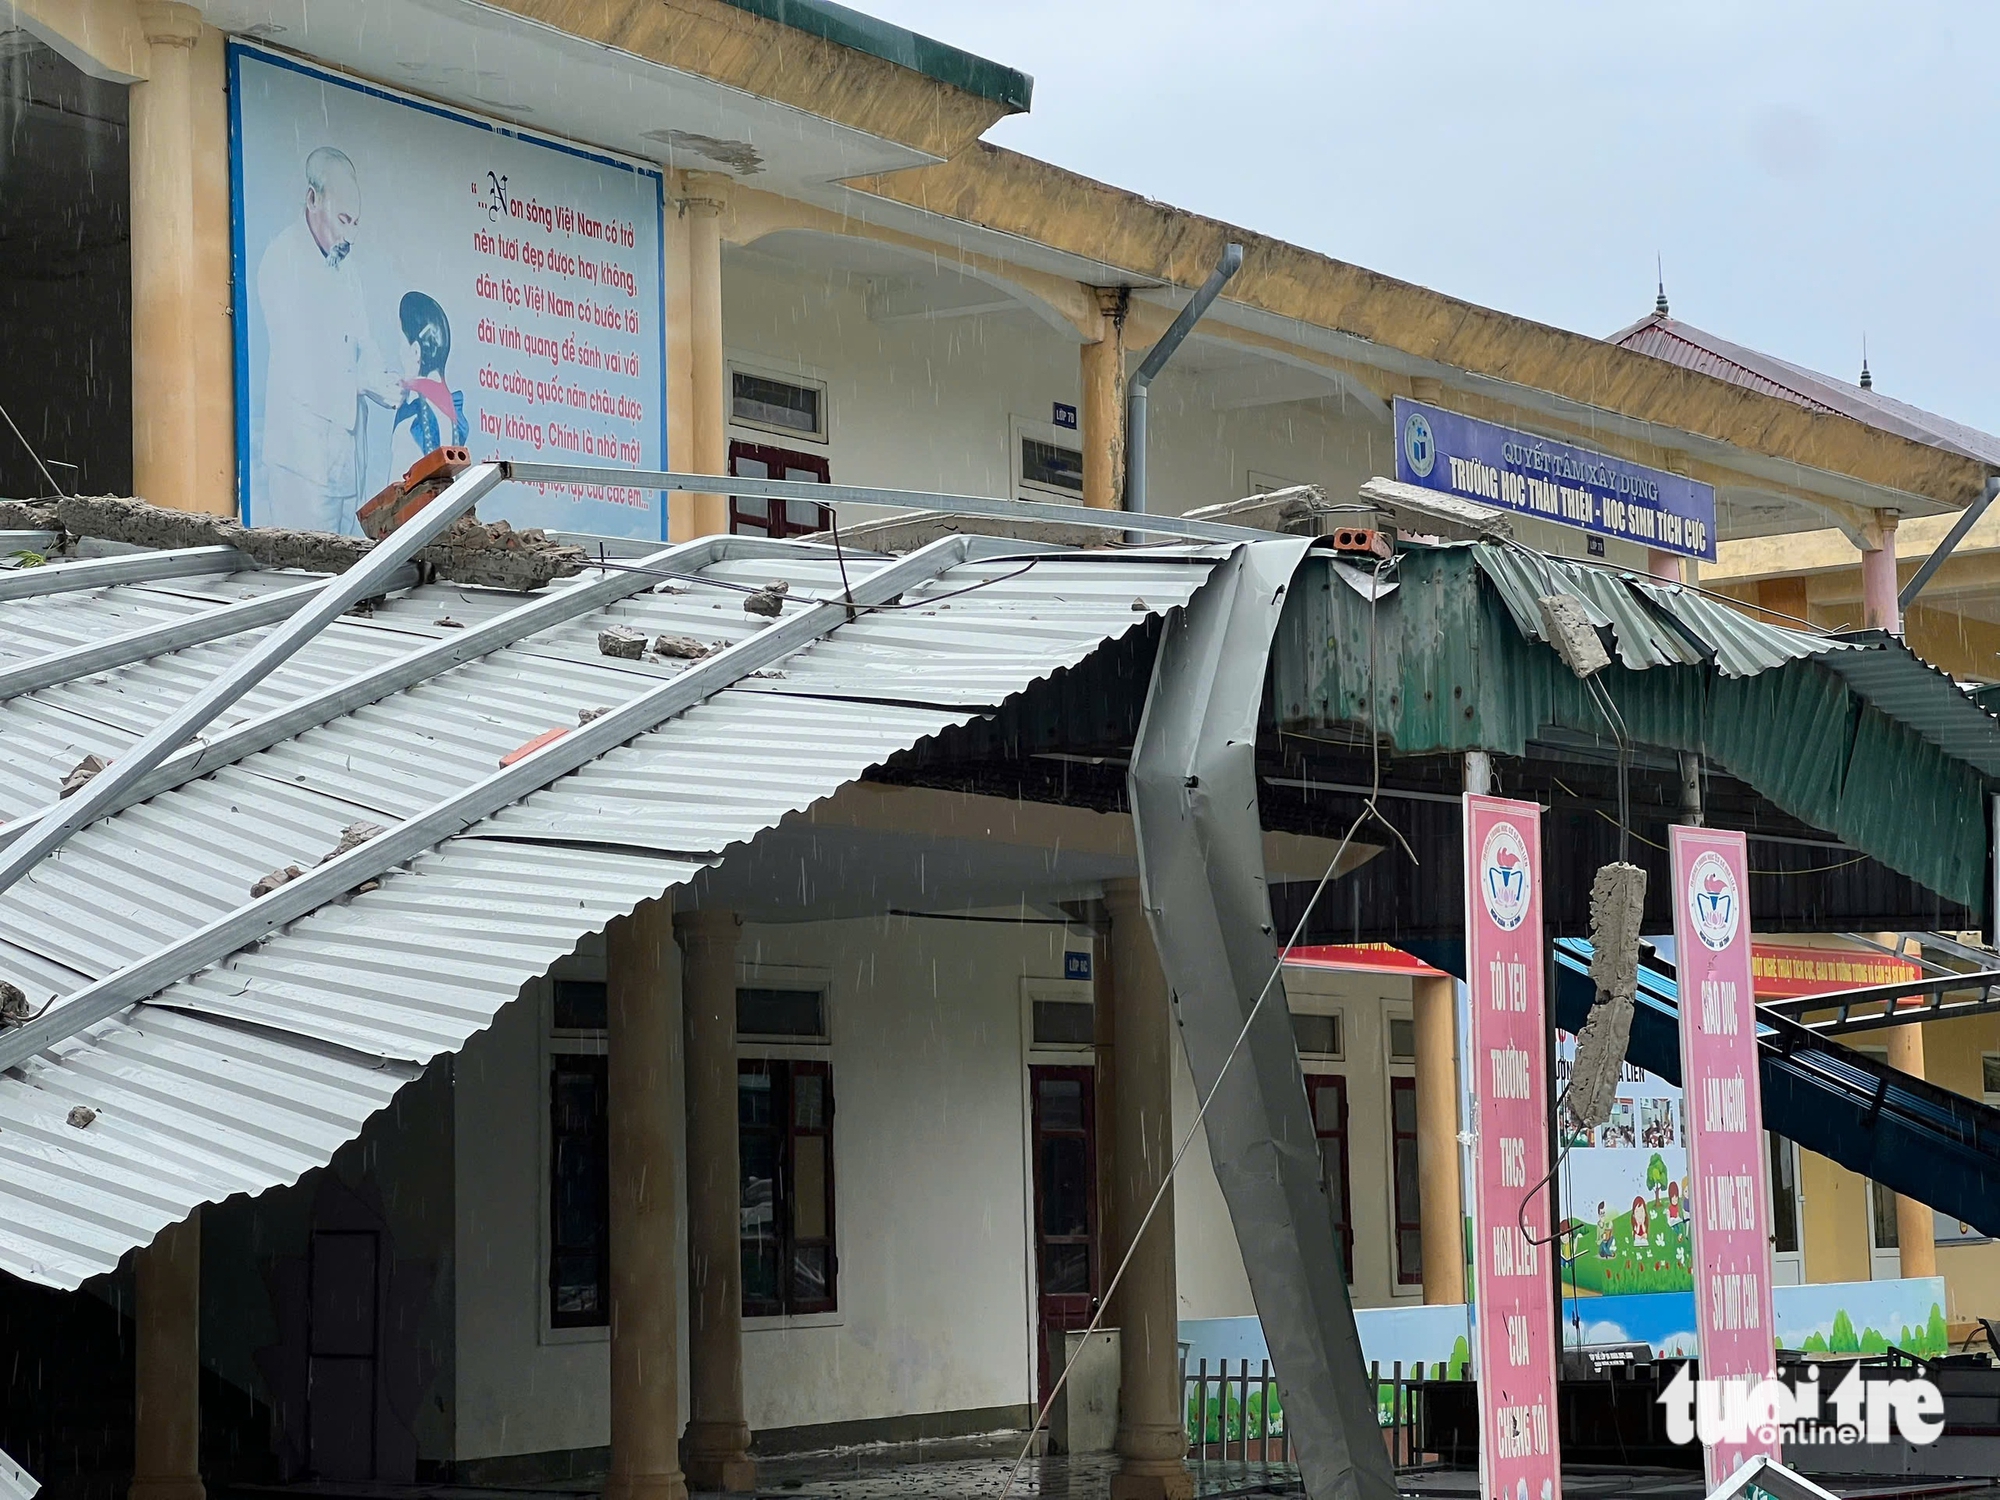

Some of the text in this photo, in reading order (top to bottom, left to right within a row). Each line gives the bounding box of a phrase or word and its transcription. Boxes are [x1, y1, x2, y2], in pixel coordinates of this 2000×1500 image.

[526, 198, 552, 233] sông
[554, 205, 575, 239] Việt
[578, 212, 603, 239] Nam
[605, 219, 618, 244] có
[620, 222, 635, 248] trở
[474, 227, 637, 297] nên tươi đẹp được hay không,
[476, 273, 639, 334] dân tộc Việt Nam có bước tới
[477, 318, 639, 377] đài vinh quang để sánh vai với
[479, 363, 643, 426] các cường quốc năm châu được
[480, 408, 641, 469] hay không. Chính là nhờ một
[1503, 442, 1659, 501] QUYẾT TÂM XÂY DỰNG
[1449, 457, 1499, 500] TRƯỜNG
[1501, 470, 1526, 509] HỌC
[1527, 477, 1559, 515] THÂN
[1560, 485, 1593, 527] THIỆN
[1602, 497, 1626, 534] HỌC
[1628, 504, 1655, 538] SINH
[1656, 508, 1683, 545] TÍCH
[1684, 518, 1706, 554] CỰC
[1489, 951, 1527, 1013] TÔI YÊU
[1721, 981, 1738, 1048] DỤC
[1490, 1037, 1530, 1100] TRƯỜNG
[1702, 1064, 1747, 1133] LÀM NGƯỜI
[1499, 1137, 1526, 1188] THCS
[1705, 1163, 1755, 1243] LÀ MỤC TIÊU
[1492, 1215, 1538, 1277] HOA LIÊN
[1711, 1254, 1760, 1343] SỐ MỘT CỦA
[1508, 1298, 1530, 1367] CỦA
[1497, 1393, 1549, 1460] CHÚNG TÔI
